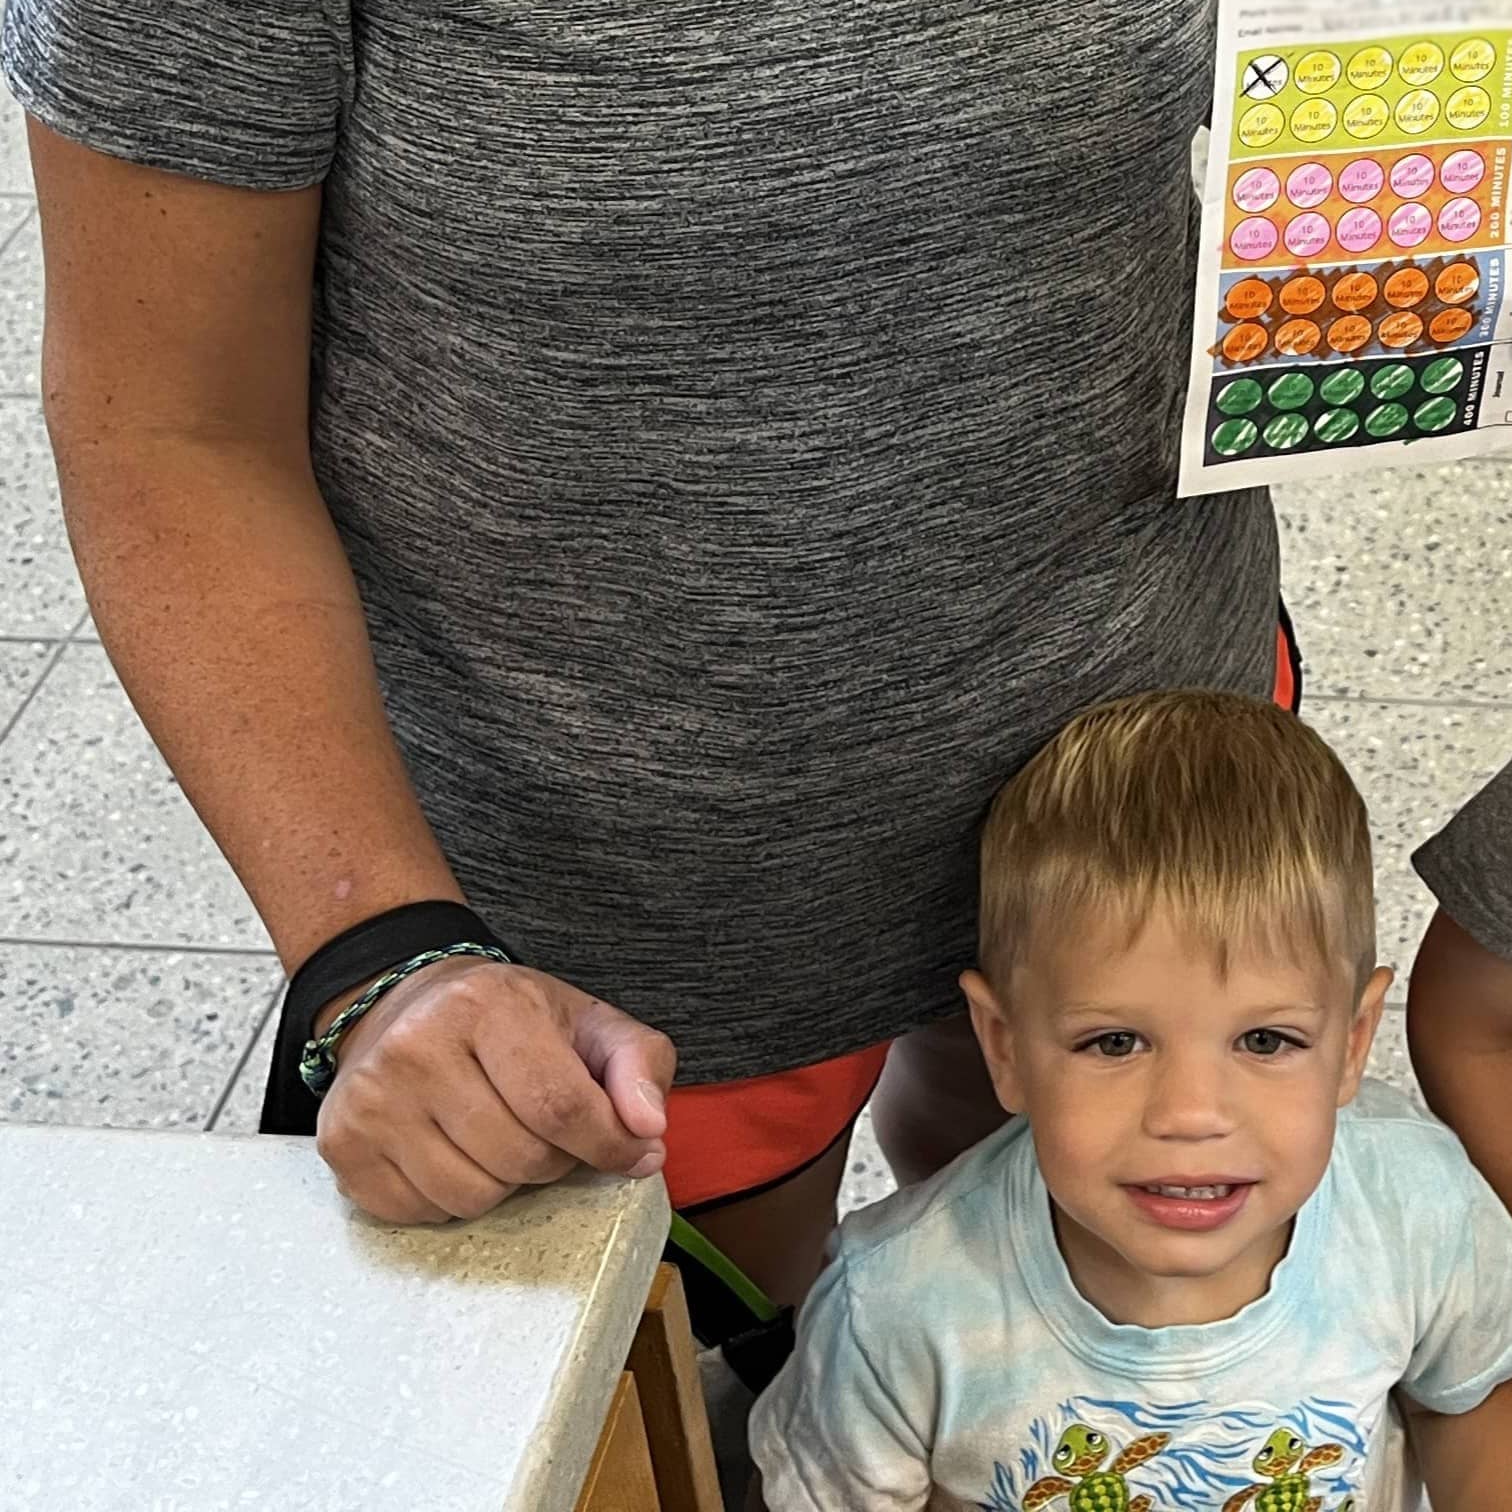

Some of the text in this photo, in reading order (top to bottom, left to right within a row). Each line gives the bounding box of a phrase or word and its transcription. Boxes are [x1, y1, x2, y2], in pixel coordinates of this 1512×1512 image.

[1489, 147, 1507, 238] 200 MINUTES
[1485, 258, 1500, 315] MINUTES
[1464, 350, 1484, 426] 400 MINUTES
